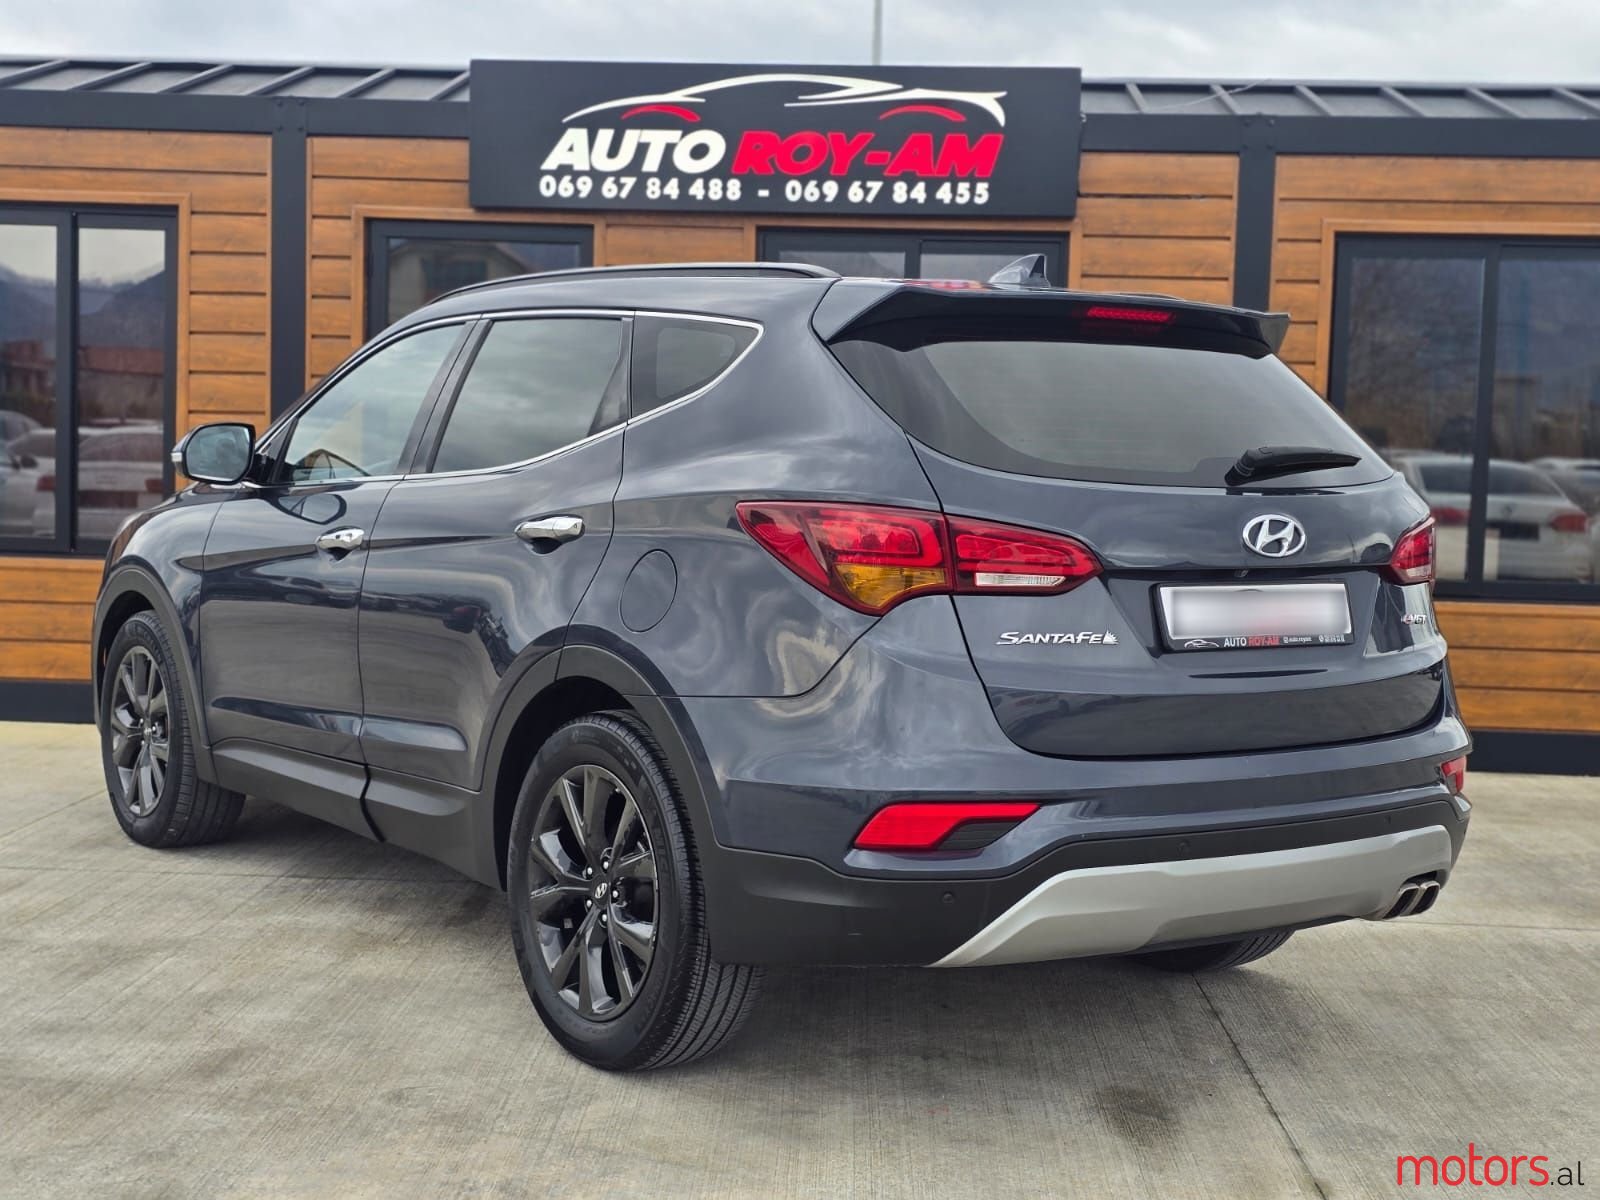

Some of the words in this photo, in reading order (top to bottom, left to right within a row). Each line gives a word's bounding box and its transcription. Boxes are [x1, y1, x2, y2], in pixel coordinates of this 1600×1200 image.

[540, 128, 727, 174] AUTO
[731, 130, 1005, 178] ROY-AM
[539, 175, 593, 198] 069
[601, 176, 638, 199] 67
[646, 177, 680, 200] 84
[688, 178, 742, 201] 488
[785, 180, 839, 202] 069
[847, 181, 884, 203] 67
[892, 181, 927, 204] 84
[935, 182, 989, 205] 455
[1223, 637, 1248, 648] AUTO
